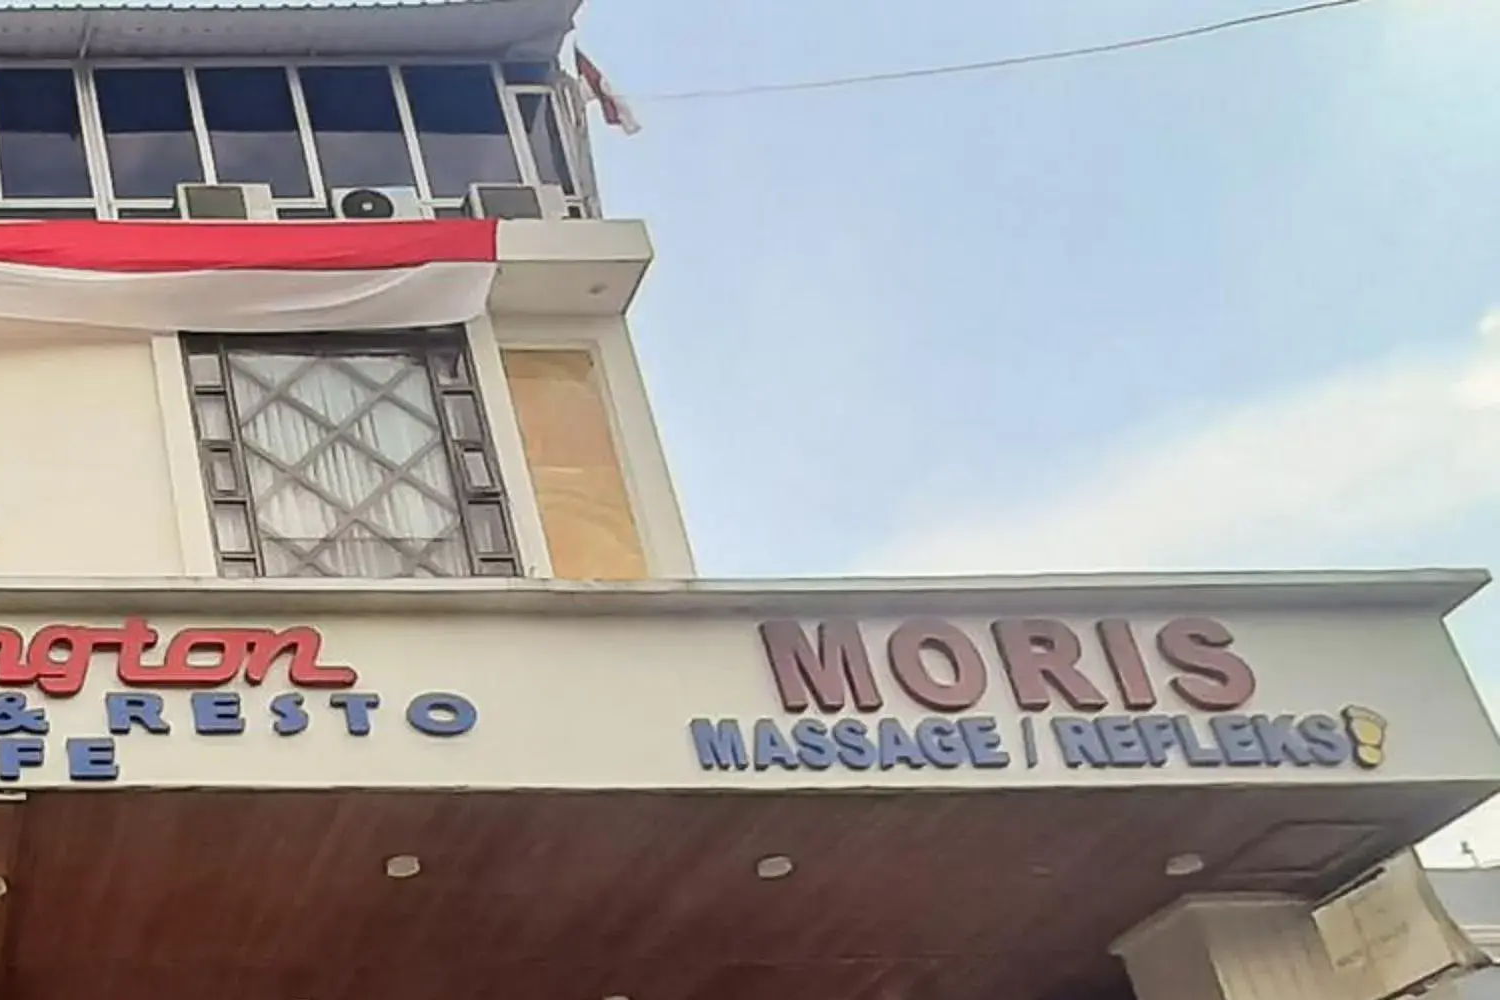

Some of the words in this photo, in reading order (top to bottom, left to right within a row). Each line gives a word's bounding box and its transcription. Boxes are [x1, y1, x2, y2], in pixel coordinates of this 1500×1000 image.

[757, 616, 1259, 712] MORIS
[103, 691, 479, 738] RESTO
[689, 714, 1011, 771] MASSAGE
[1049, 714, 1357, 769] REFLEKS
